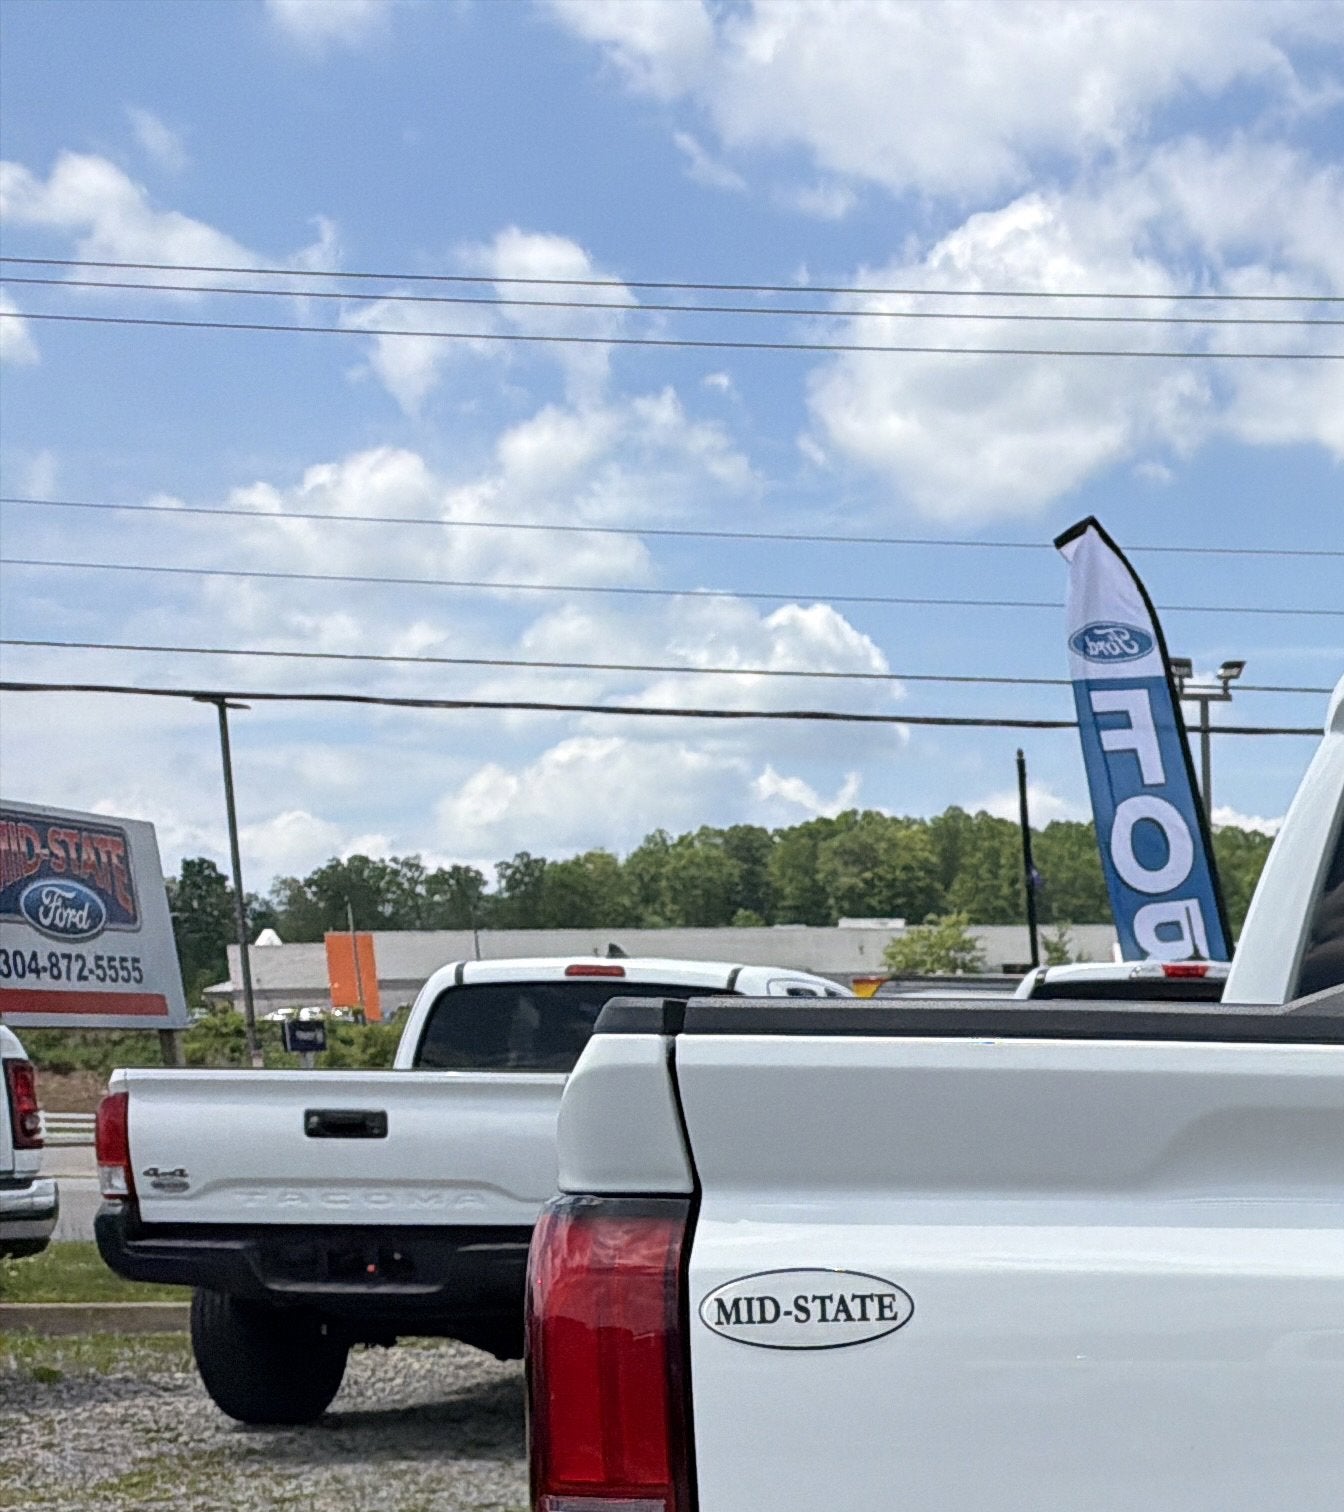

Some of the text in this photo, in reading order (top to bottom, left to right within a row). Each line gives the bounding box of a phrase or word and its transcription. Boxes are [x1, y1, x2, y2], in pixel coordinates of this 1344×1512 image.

[38, 886, 91, 930] Ford
[0, 948, 144, 984] 304-872-5555
[231, 1190, 487, 1210] TACOMA
[714, 1293, 898, 1326] MID-STATE
